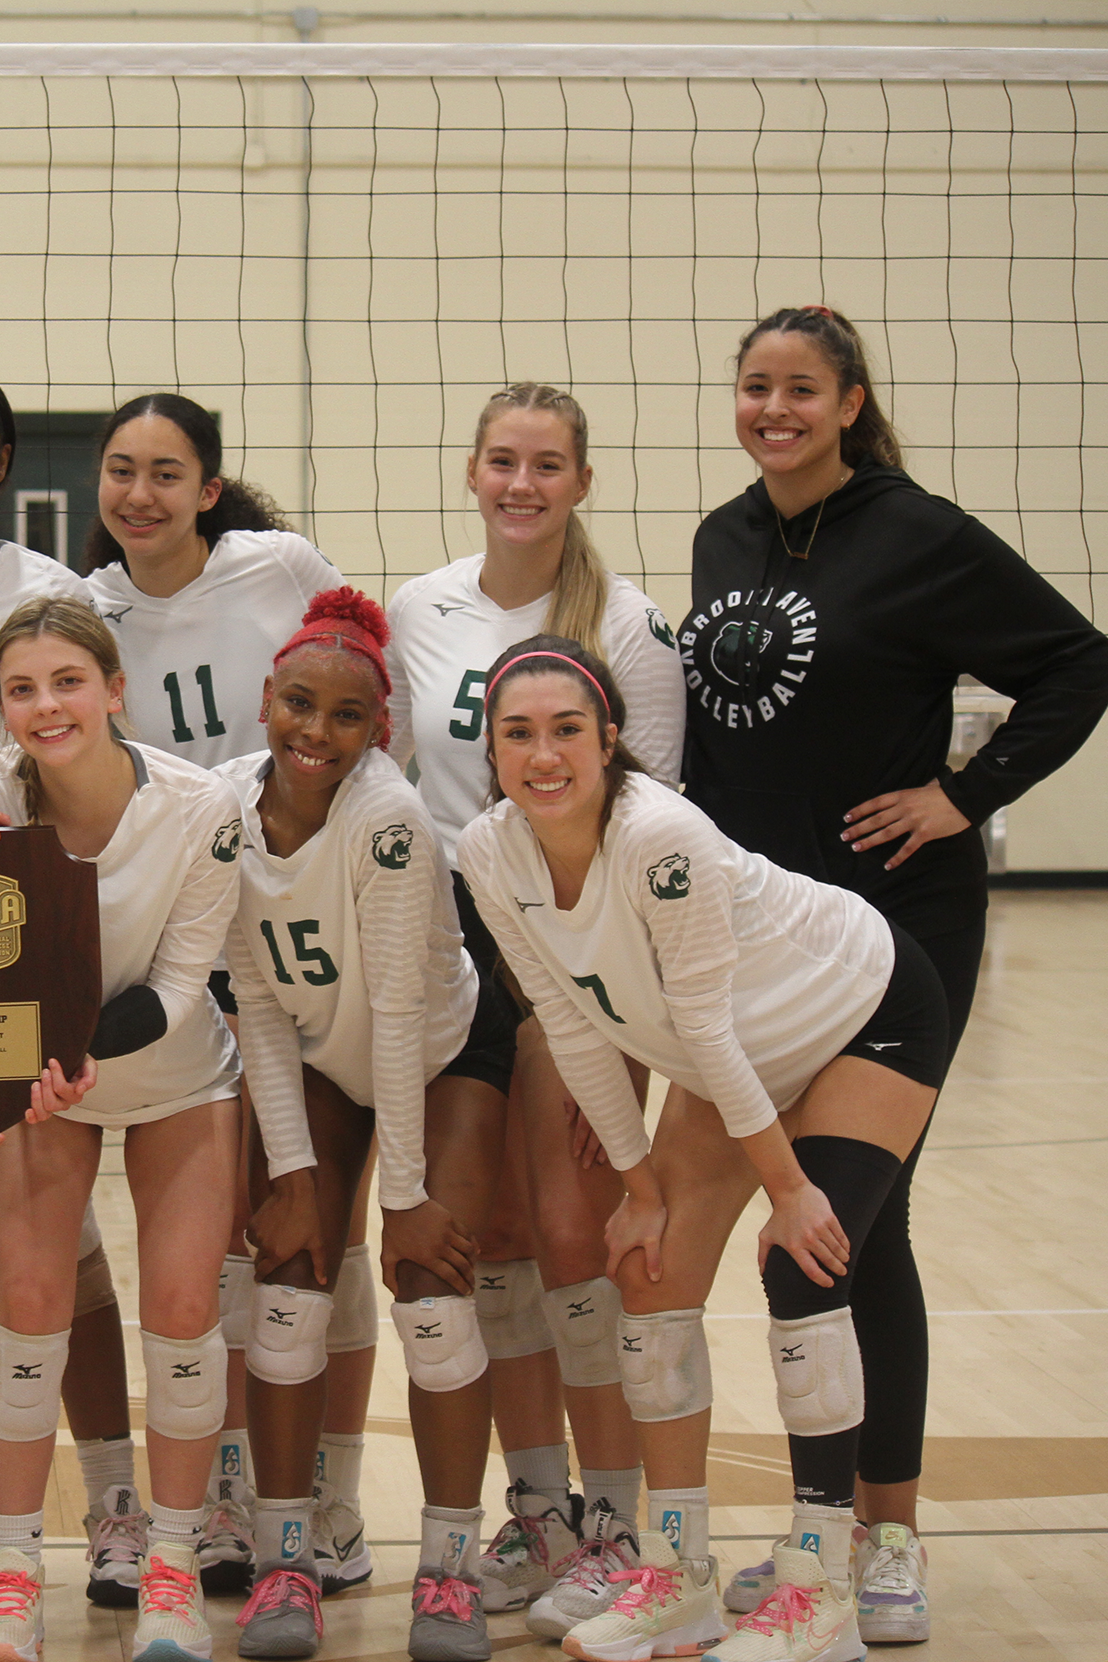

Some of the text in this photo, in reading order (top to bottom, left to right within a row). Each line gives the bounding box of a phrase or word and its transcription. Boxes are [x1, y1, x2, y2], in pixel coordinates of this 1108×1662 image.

[163, 664, 226, 743] 11
[448, 669, 485, 742] 5
[259, 919, 339, 986] 15
[569, 973, 627, 1025] 7
